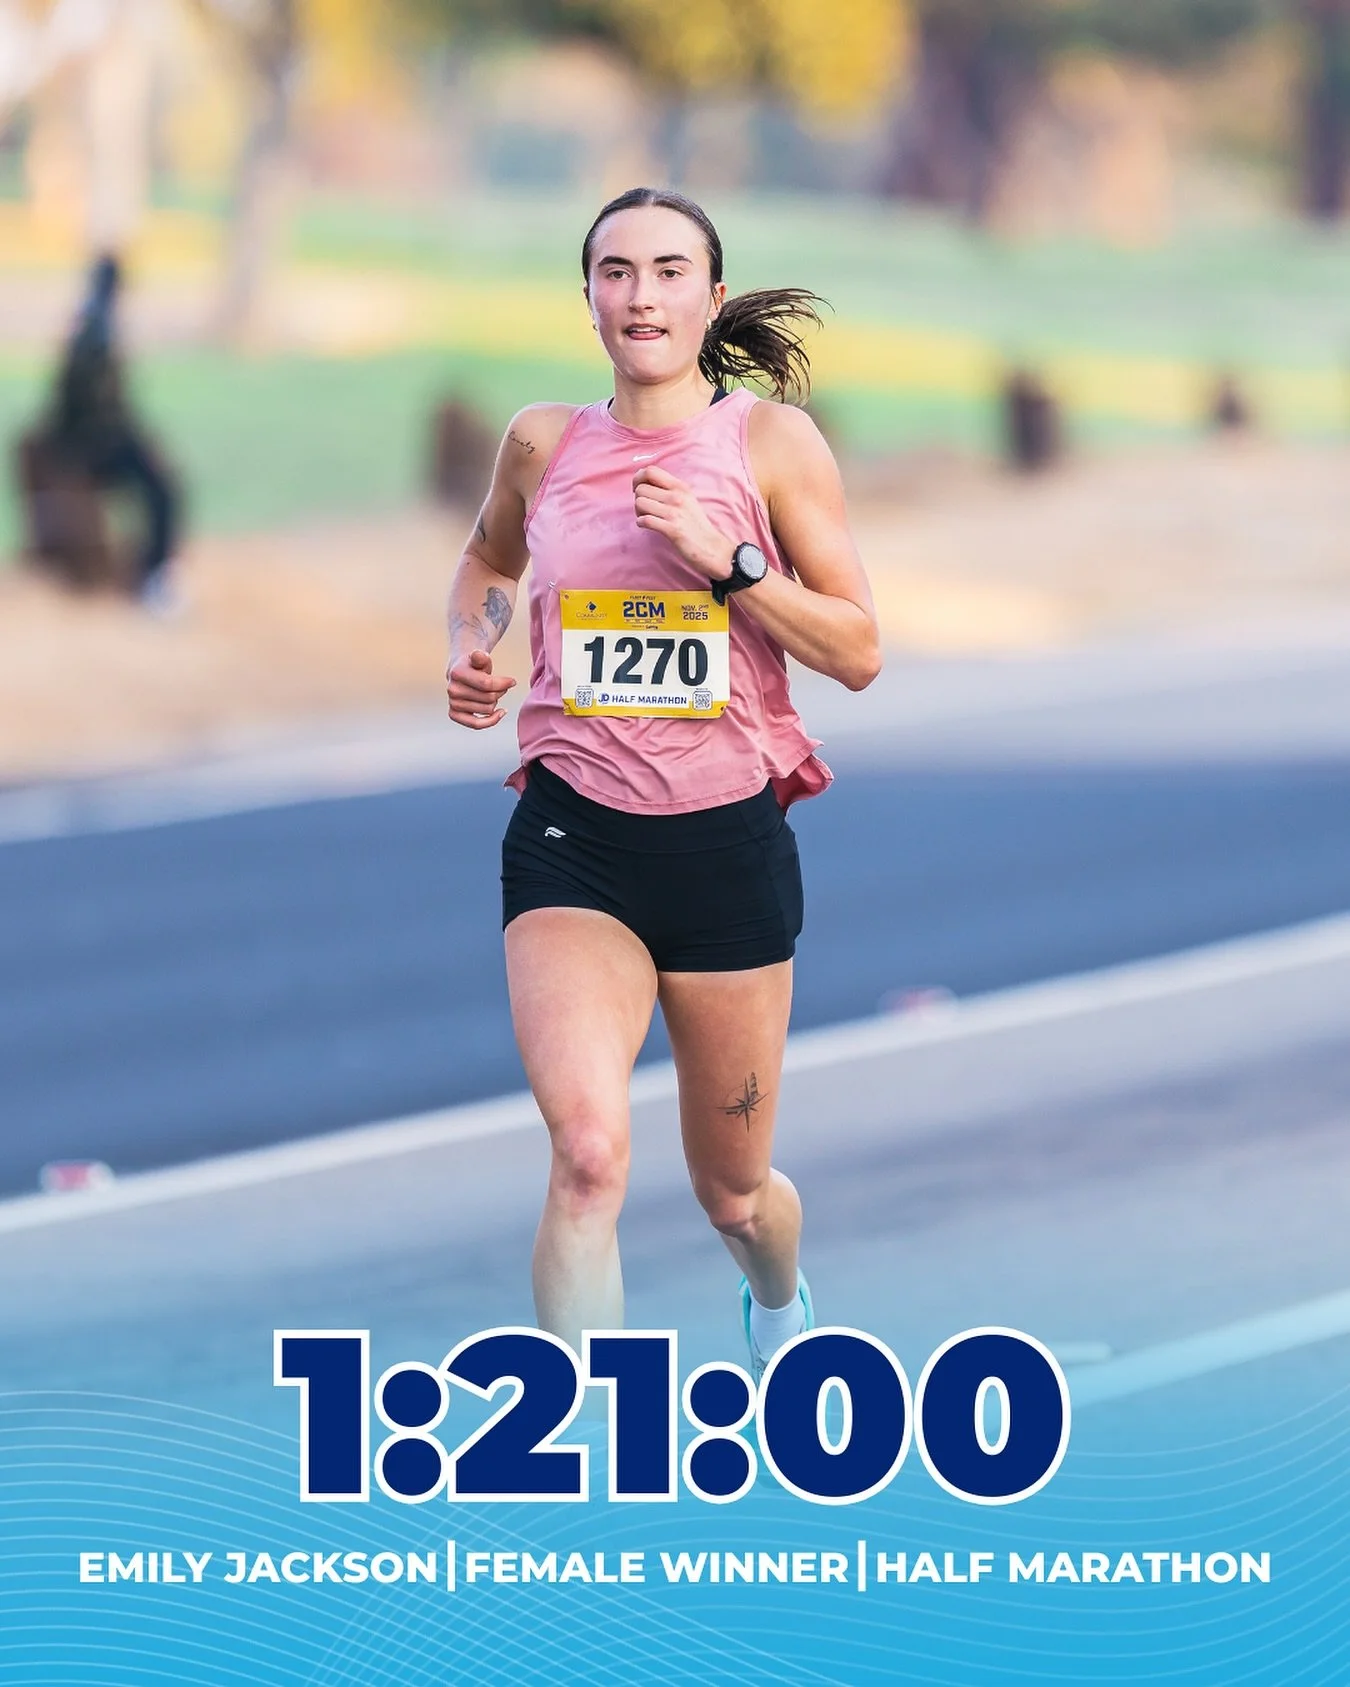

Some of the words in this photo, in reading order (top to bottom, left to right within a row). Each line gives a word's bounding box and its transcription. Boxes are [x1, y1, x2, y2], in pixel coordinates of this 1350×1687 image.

[623, 601, 666, 618] 2CM
[681, 604, 697, 612] NOV.
[682, 611, 709, 621] 2025
[584, 636, 708, 686] 1270
[612, 695, 636, 703] HALF
[637, 695, 687, 704] MARATHON
